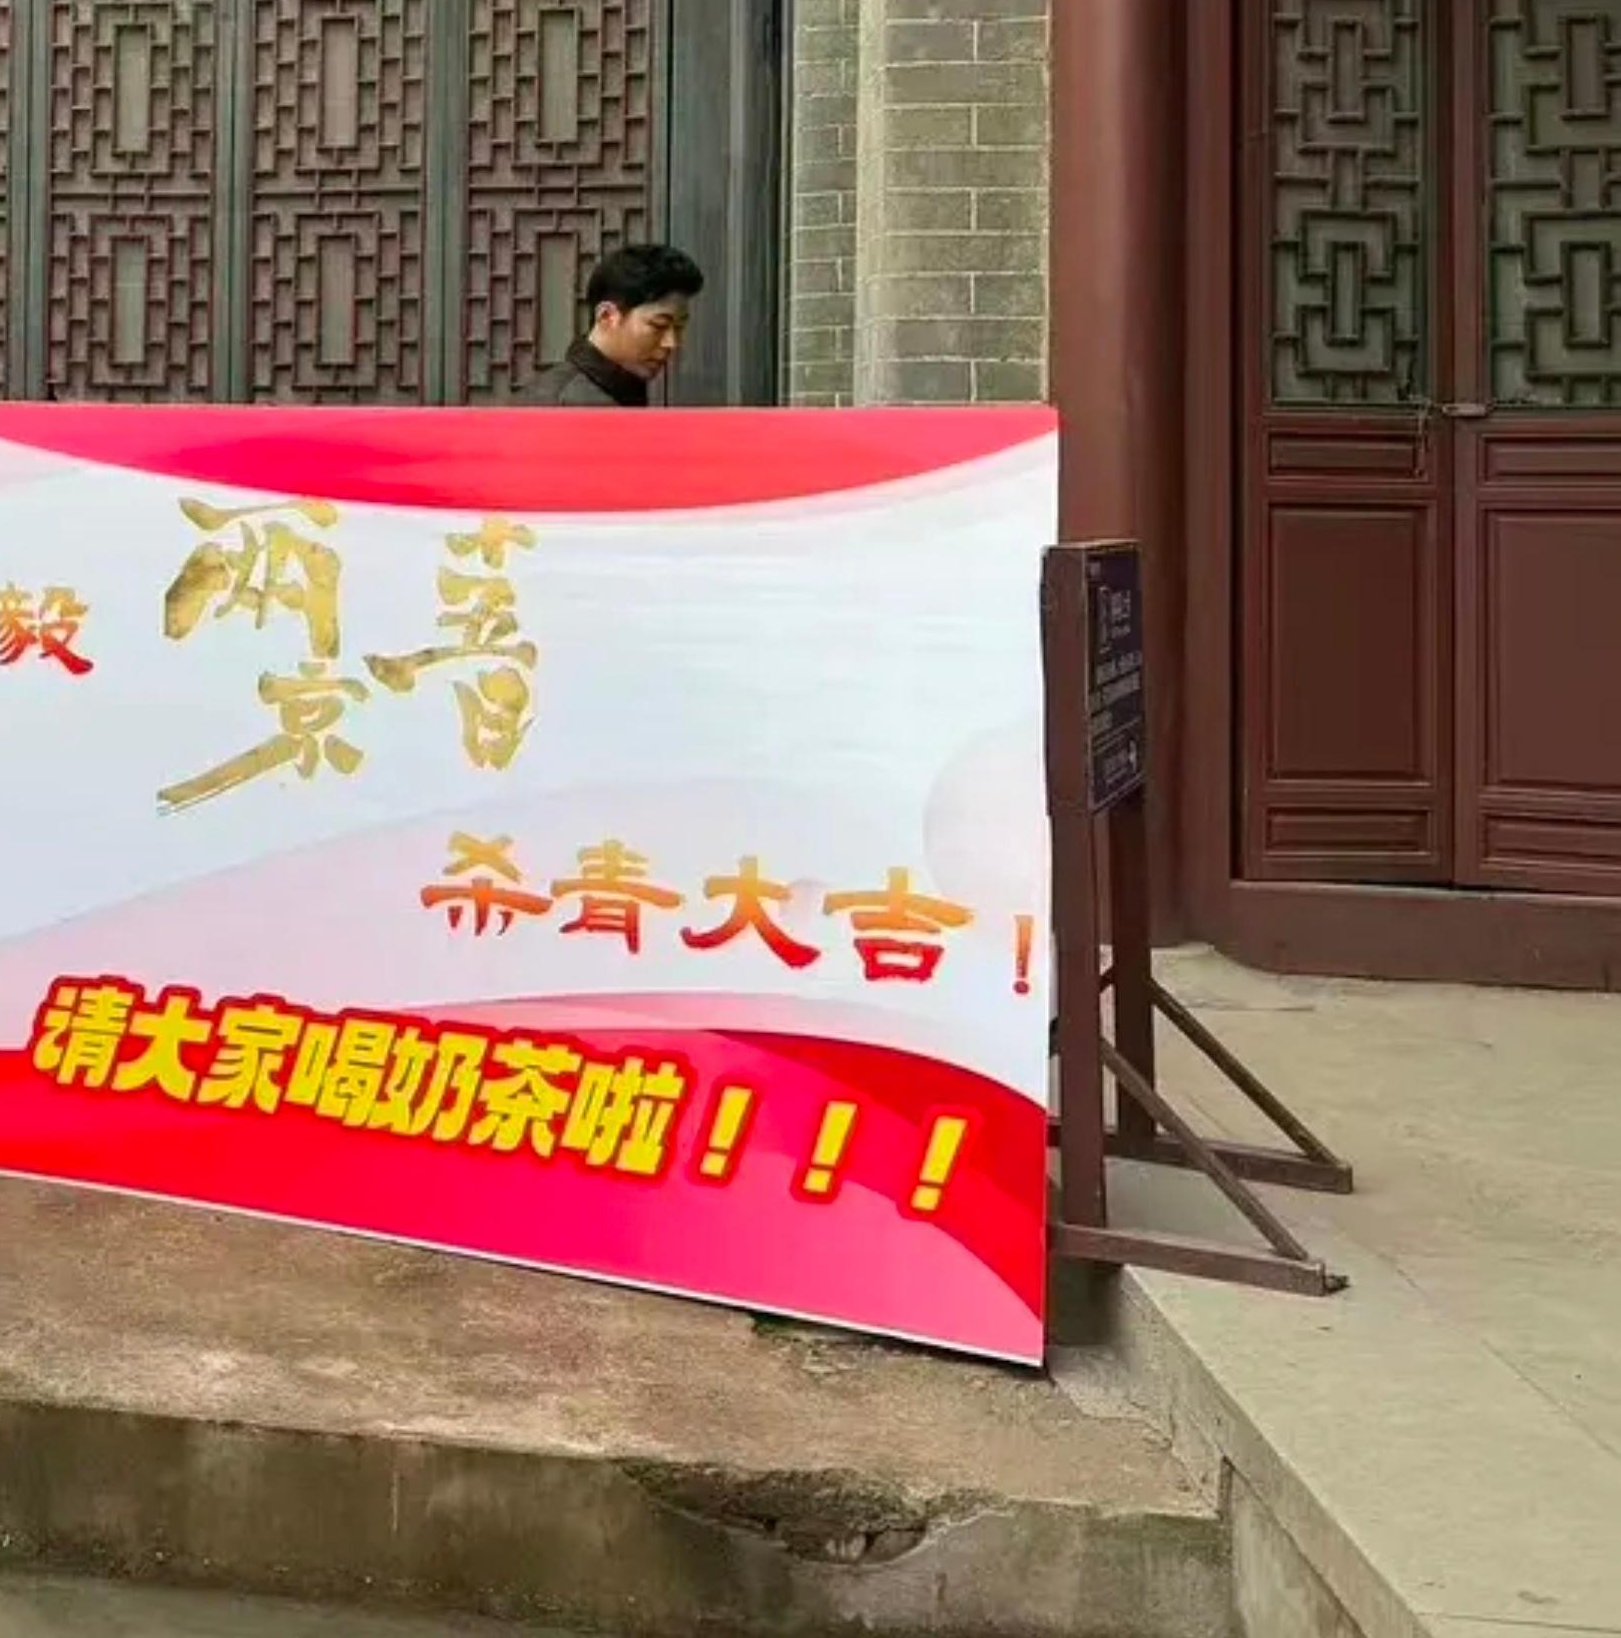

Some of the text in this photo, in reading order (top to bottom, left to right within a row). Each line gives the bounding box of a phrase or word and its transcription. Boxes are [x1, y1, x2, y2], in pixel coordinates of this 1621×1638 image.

[419, 830, 1035, 996] 杀青大吉！
[33, 983, 969, 1213] 请大家喝奶茶啦！！！
